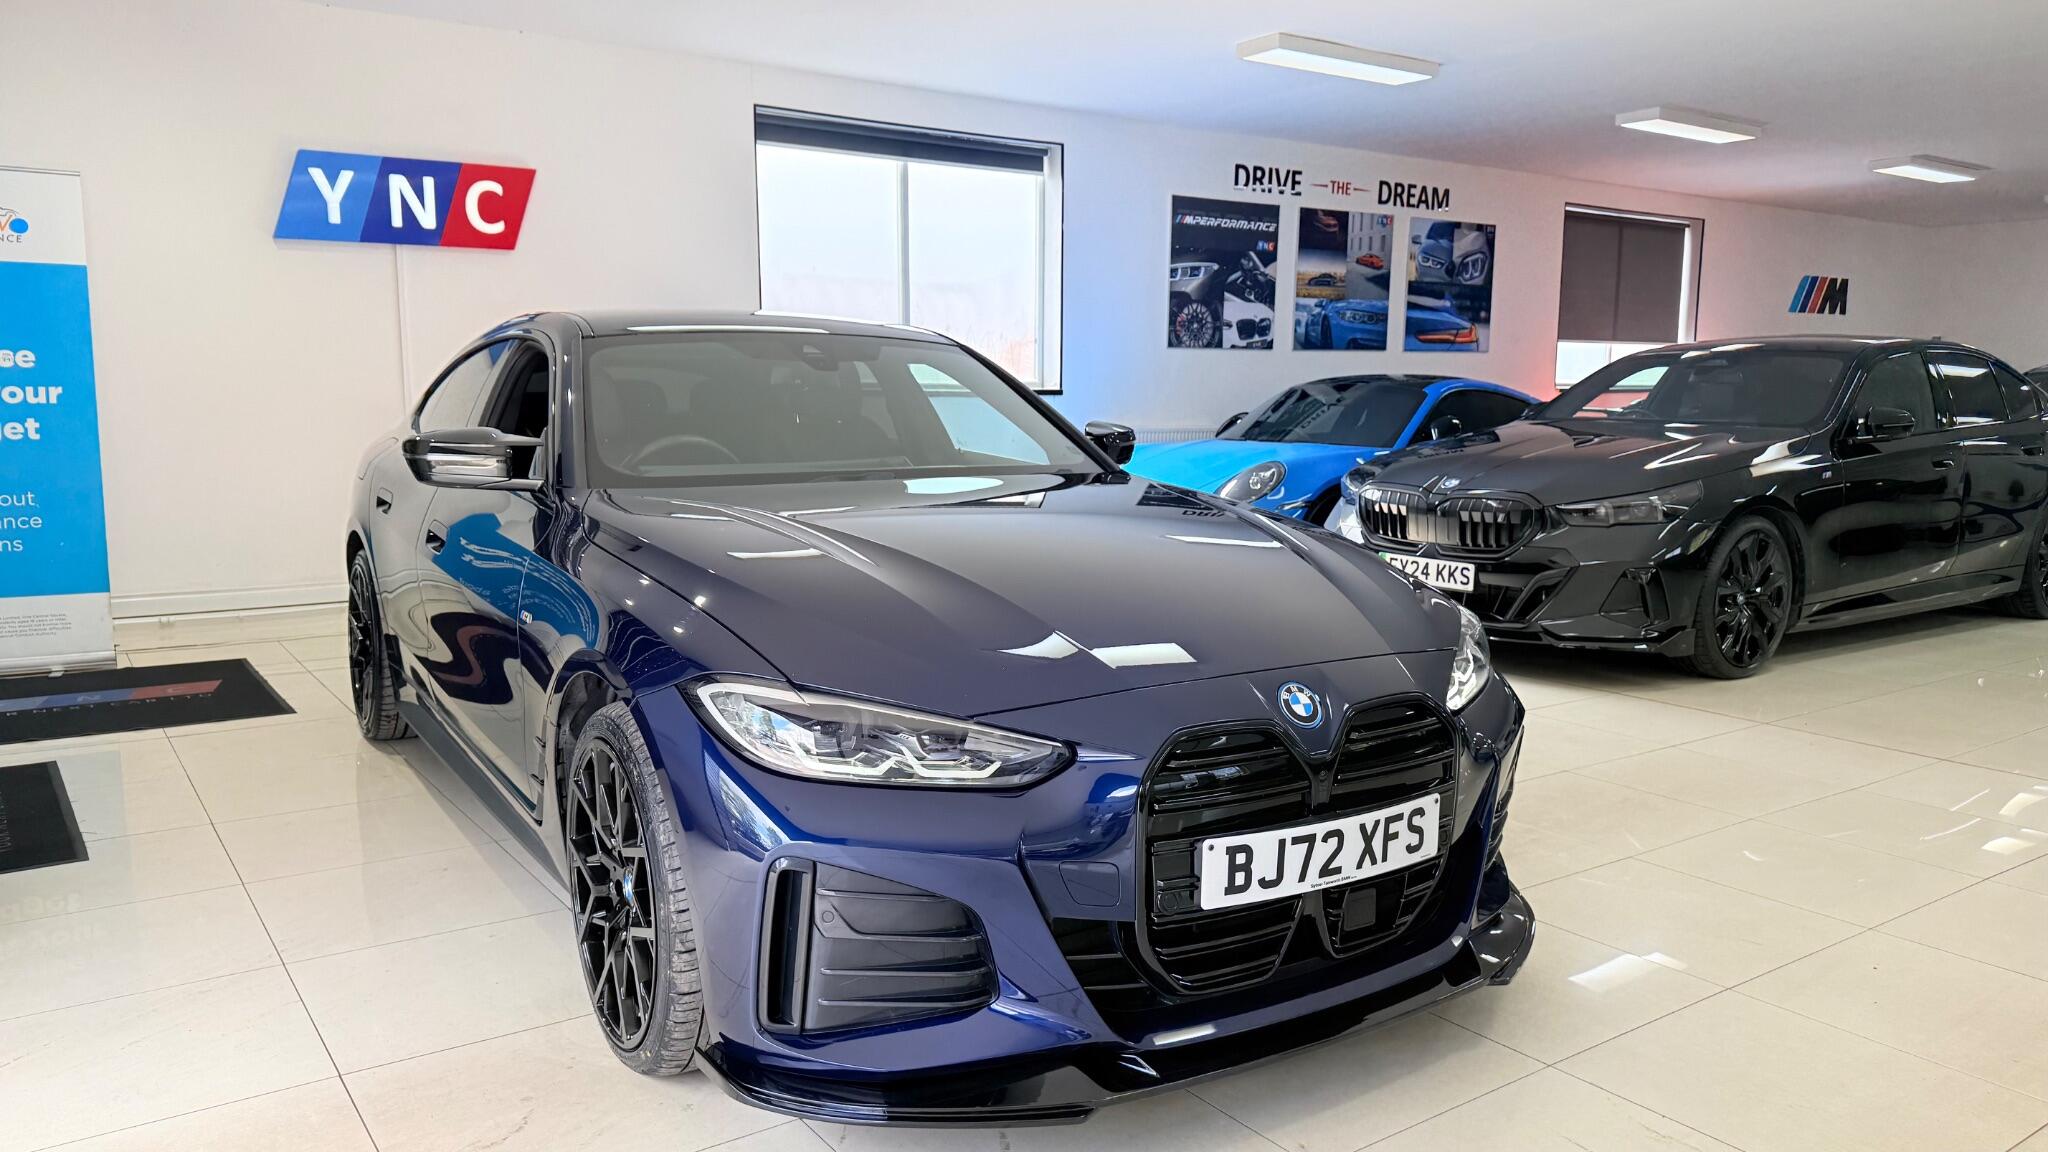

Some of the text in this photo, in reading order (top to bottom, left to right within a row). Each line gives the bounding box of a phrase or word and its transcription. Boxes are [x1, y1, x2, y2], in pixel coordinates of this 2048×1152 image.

[307, 166, 506, 235] YNC
[1234, 163, 1450, 212] DRIVE THE DREAM
[0, 385, 63, 404] our
[0, 417, 40, 440] et
[1436, 563, 1471, 586] KKS
[1224, 806, 1426, 896] BJ72 XFS
